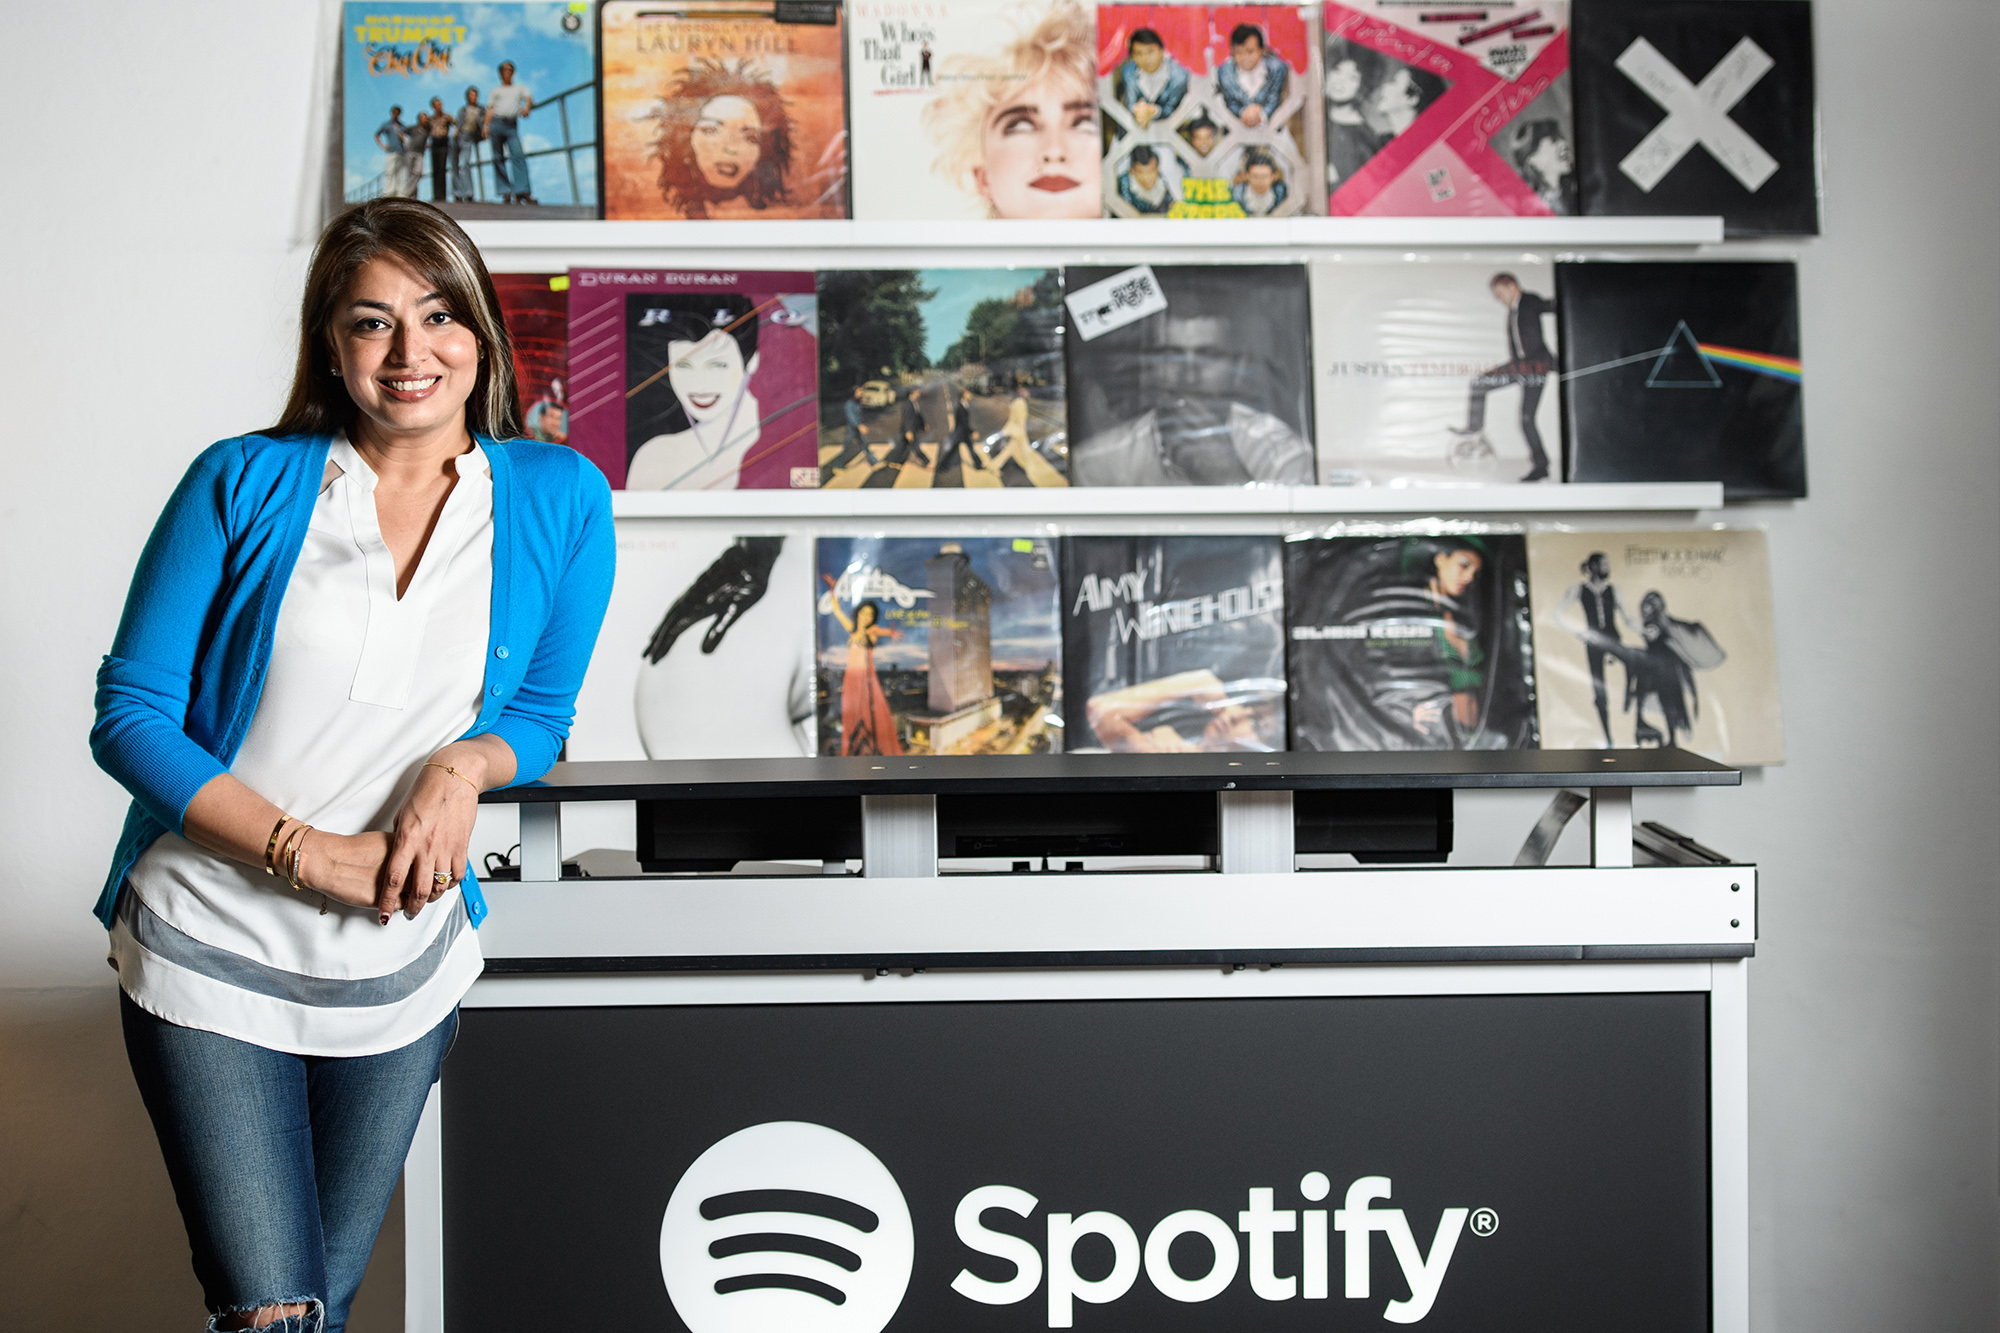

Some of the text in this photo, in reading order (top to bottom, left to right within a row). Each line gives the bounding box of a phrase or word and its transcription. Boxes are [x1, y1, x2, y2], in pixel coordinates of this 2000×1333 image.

[354, 25, 467, 43] TRUMPET
[636, 34, 798, 54] LAURYN HILL
[1182, 177, 1232, 202] THE
[578, 272, 739, 287] DURAN DURAN
[1072, 569, 1148, 617] AMY
[950, 1171, 1469, 1328] Spotify
